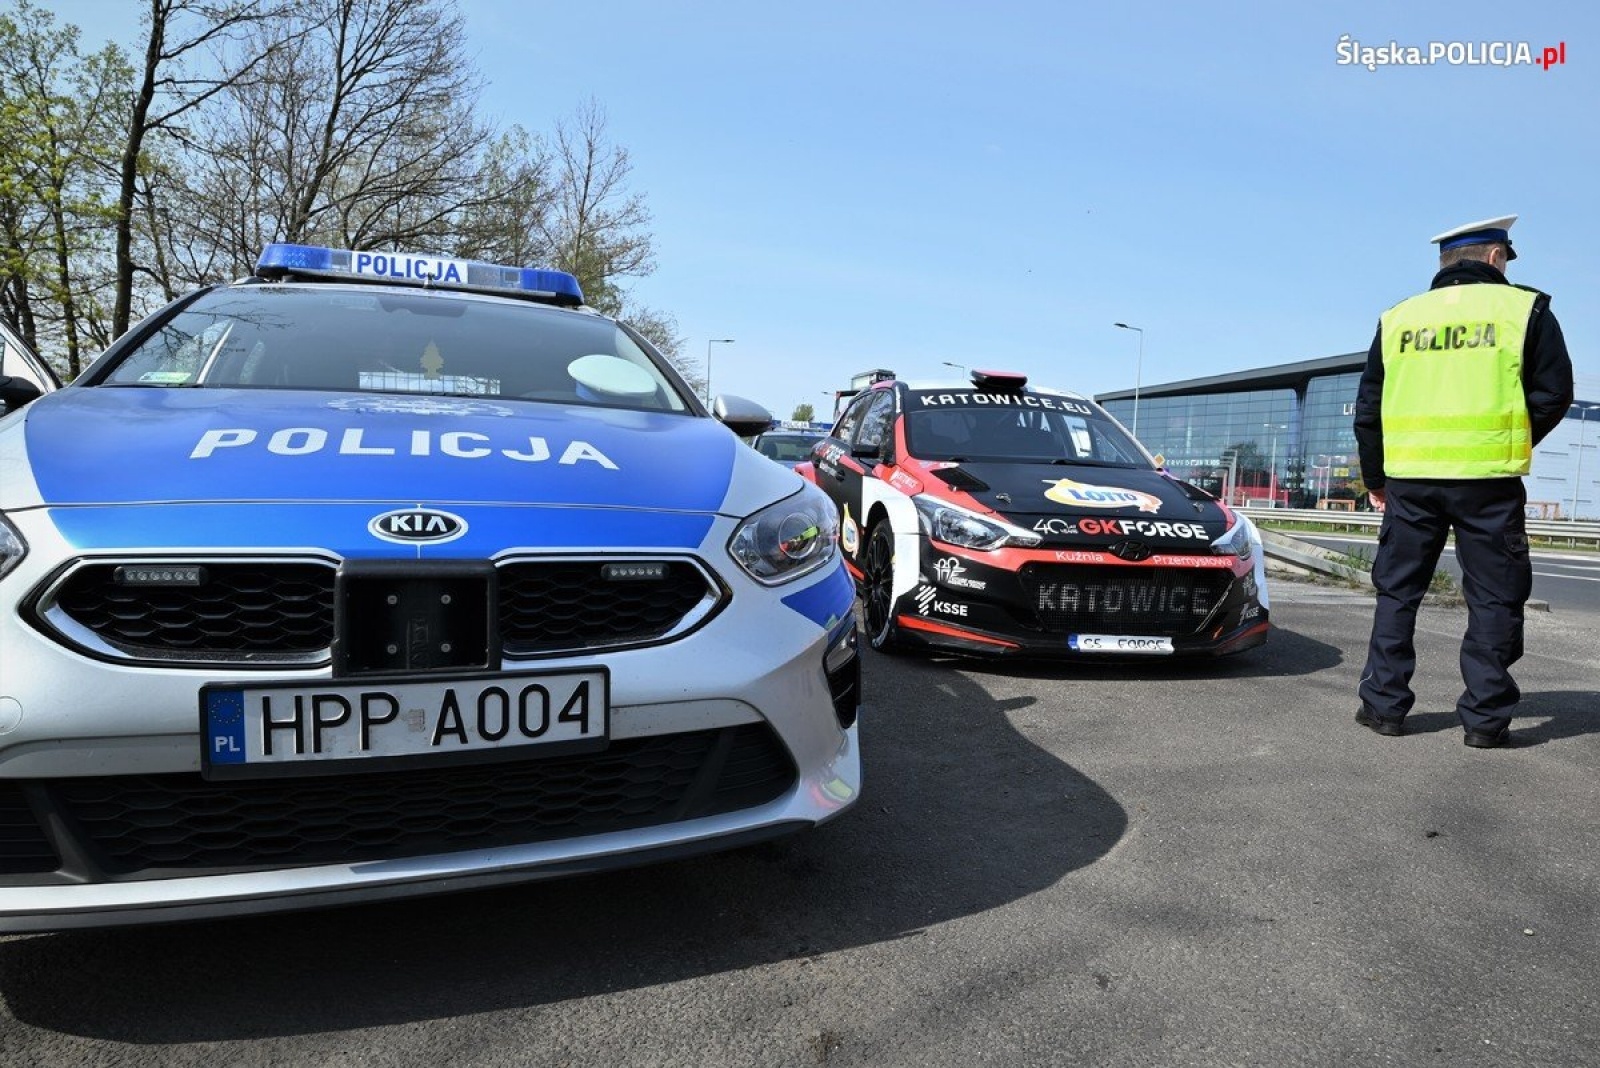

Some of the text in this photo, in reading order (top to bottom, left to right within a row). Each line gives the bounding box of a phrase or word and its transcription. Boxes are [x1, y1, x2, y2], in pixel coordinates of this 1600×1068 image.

[357, 254, 461, 283] POLICJA
[1400, 323, 1497, 353] POLICJA
[920, 394, 1093, 415] KATOWICE.EU
[190, 428, 620, 470] POLICJA
[1067, 488, 1138, 502] LOTTO
[390, 515, 449, 532] KIA
[1055, 551, 1104, 563] Kuźnia
[934, 600, 968, 616] KSSE
[1039, 583, 1210, 615] KATOWICE
[261, 680, 590, 757] HPP A004
[215, 736, 241, 752] PL
